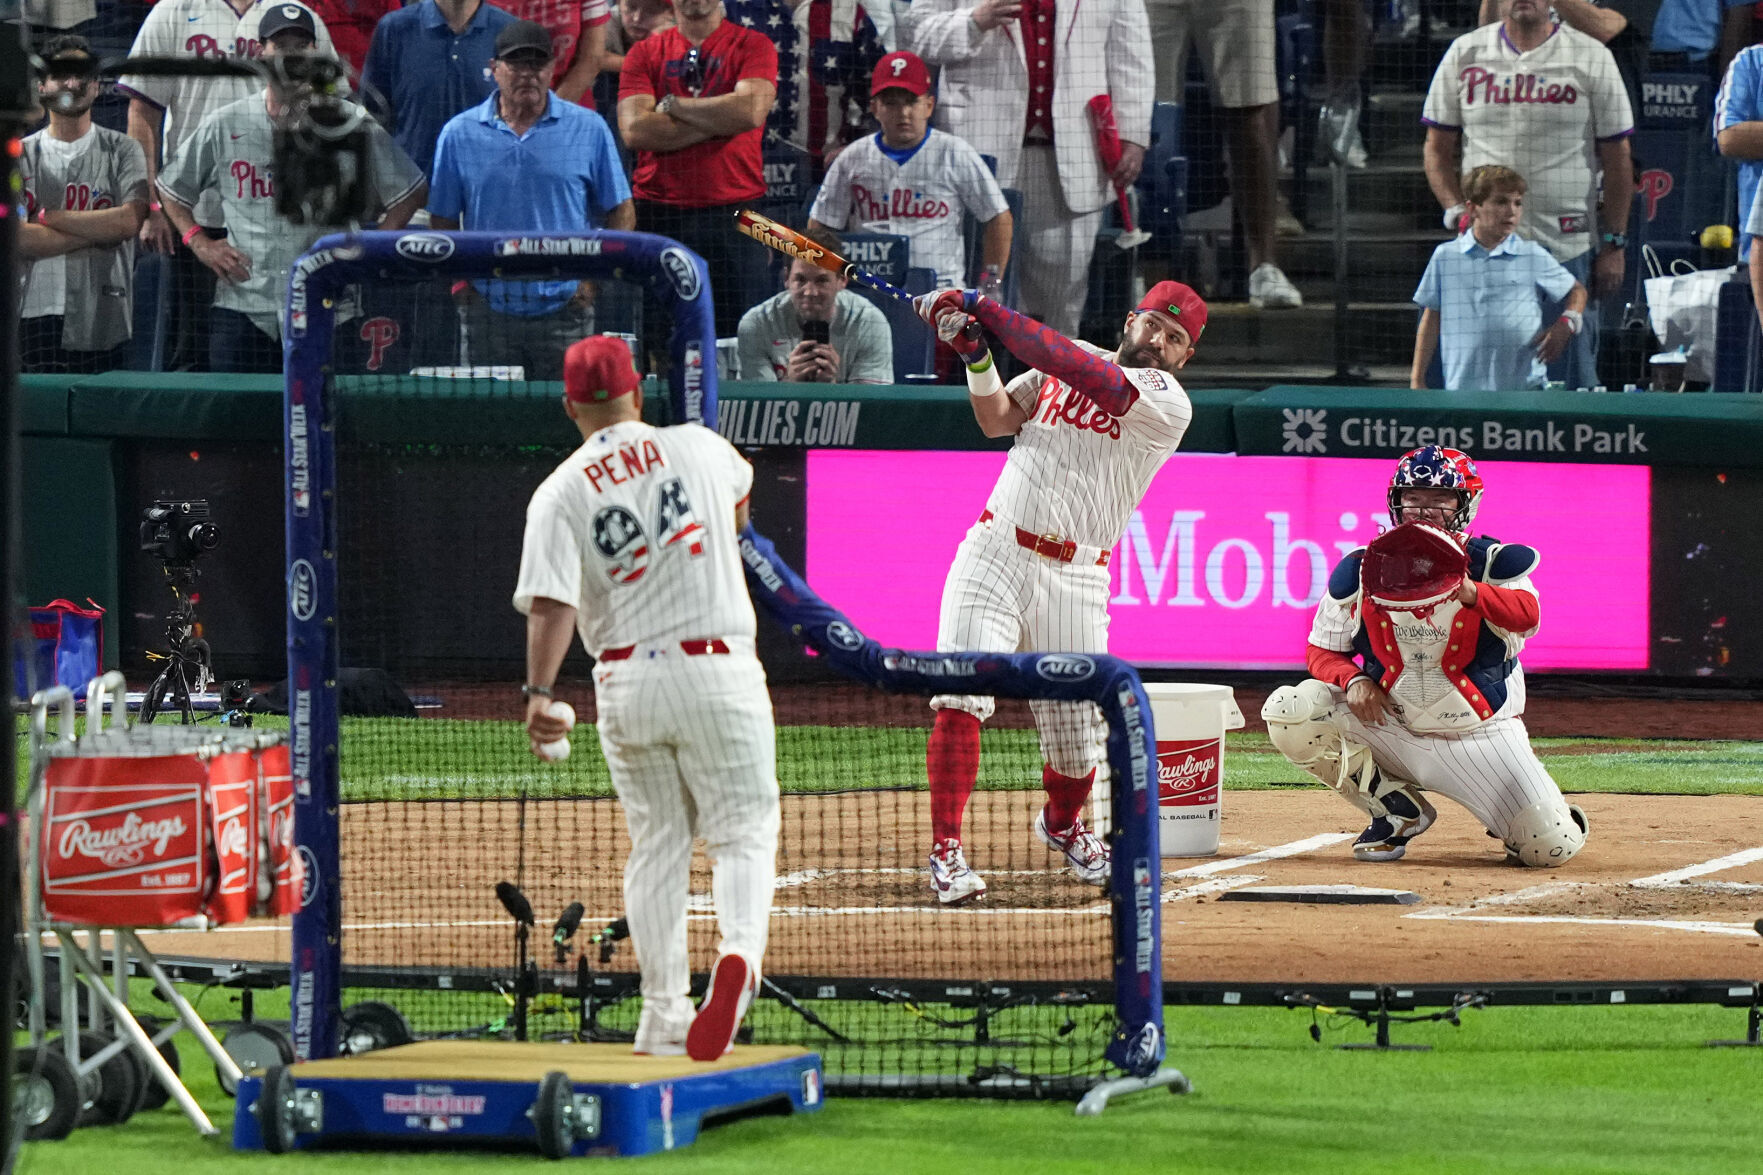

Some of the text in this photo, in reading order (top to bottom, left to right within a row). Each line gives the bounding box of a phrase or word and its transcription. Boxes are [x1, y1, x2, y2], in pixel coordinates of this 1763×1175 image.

[1461, 66, 1577, 104] Phillies
[1642, 84, 1698, 104] PHLY
[764, 163, 796, 183] HLY
[848, 184, 950, 220] Phillies
[361, 317, 400, 370] P
[718, 400, 861, 445] HILLIES.COM
[1340, 418, 1649, 453] Citizens Bank Park
[590, 476, 710, 586] 94
[1110, 510, 1396, 609] Mobi
[59, 812, 187, 859] Rawlings
[1170, 813, 1207, 821] BASEBALL
